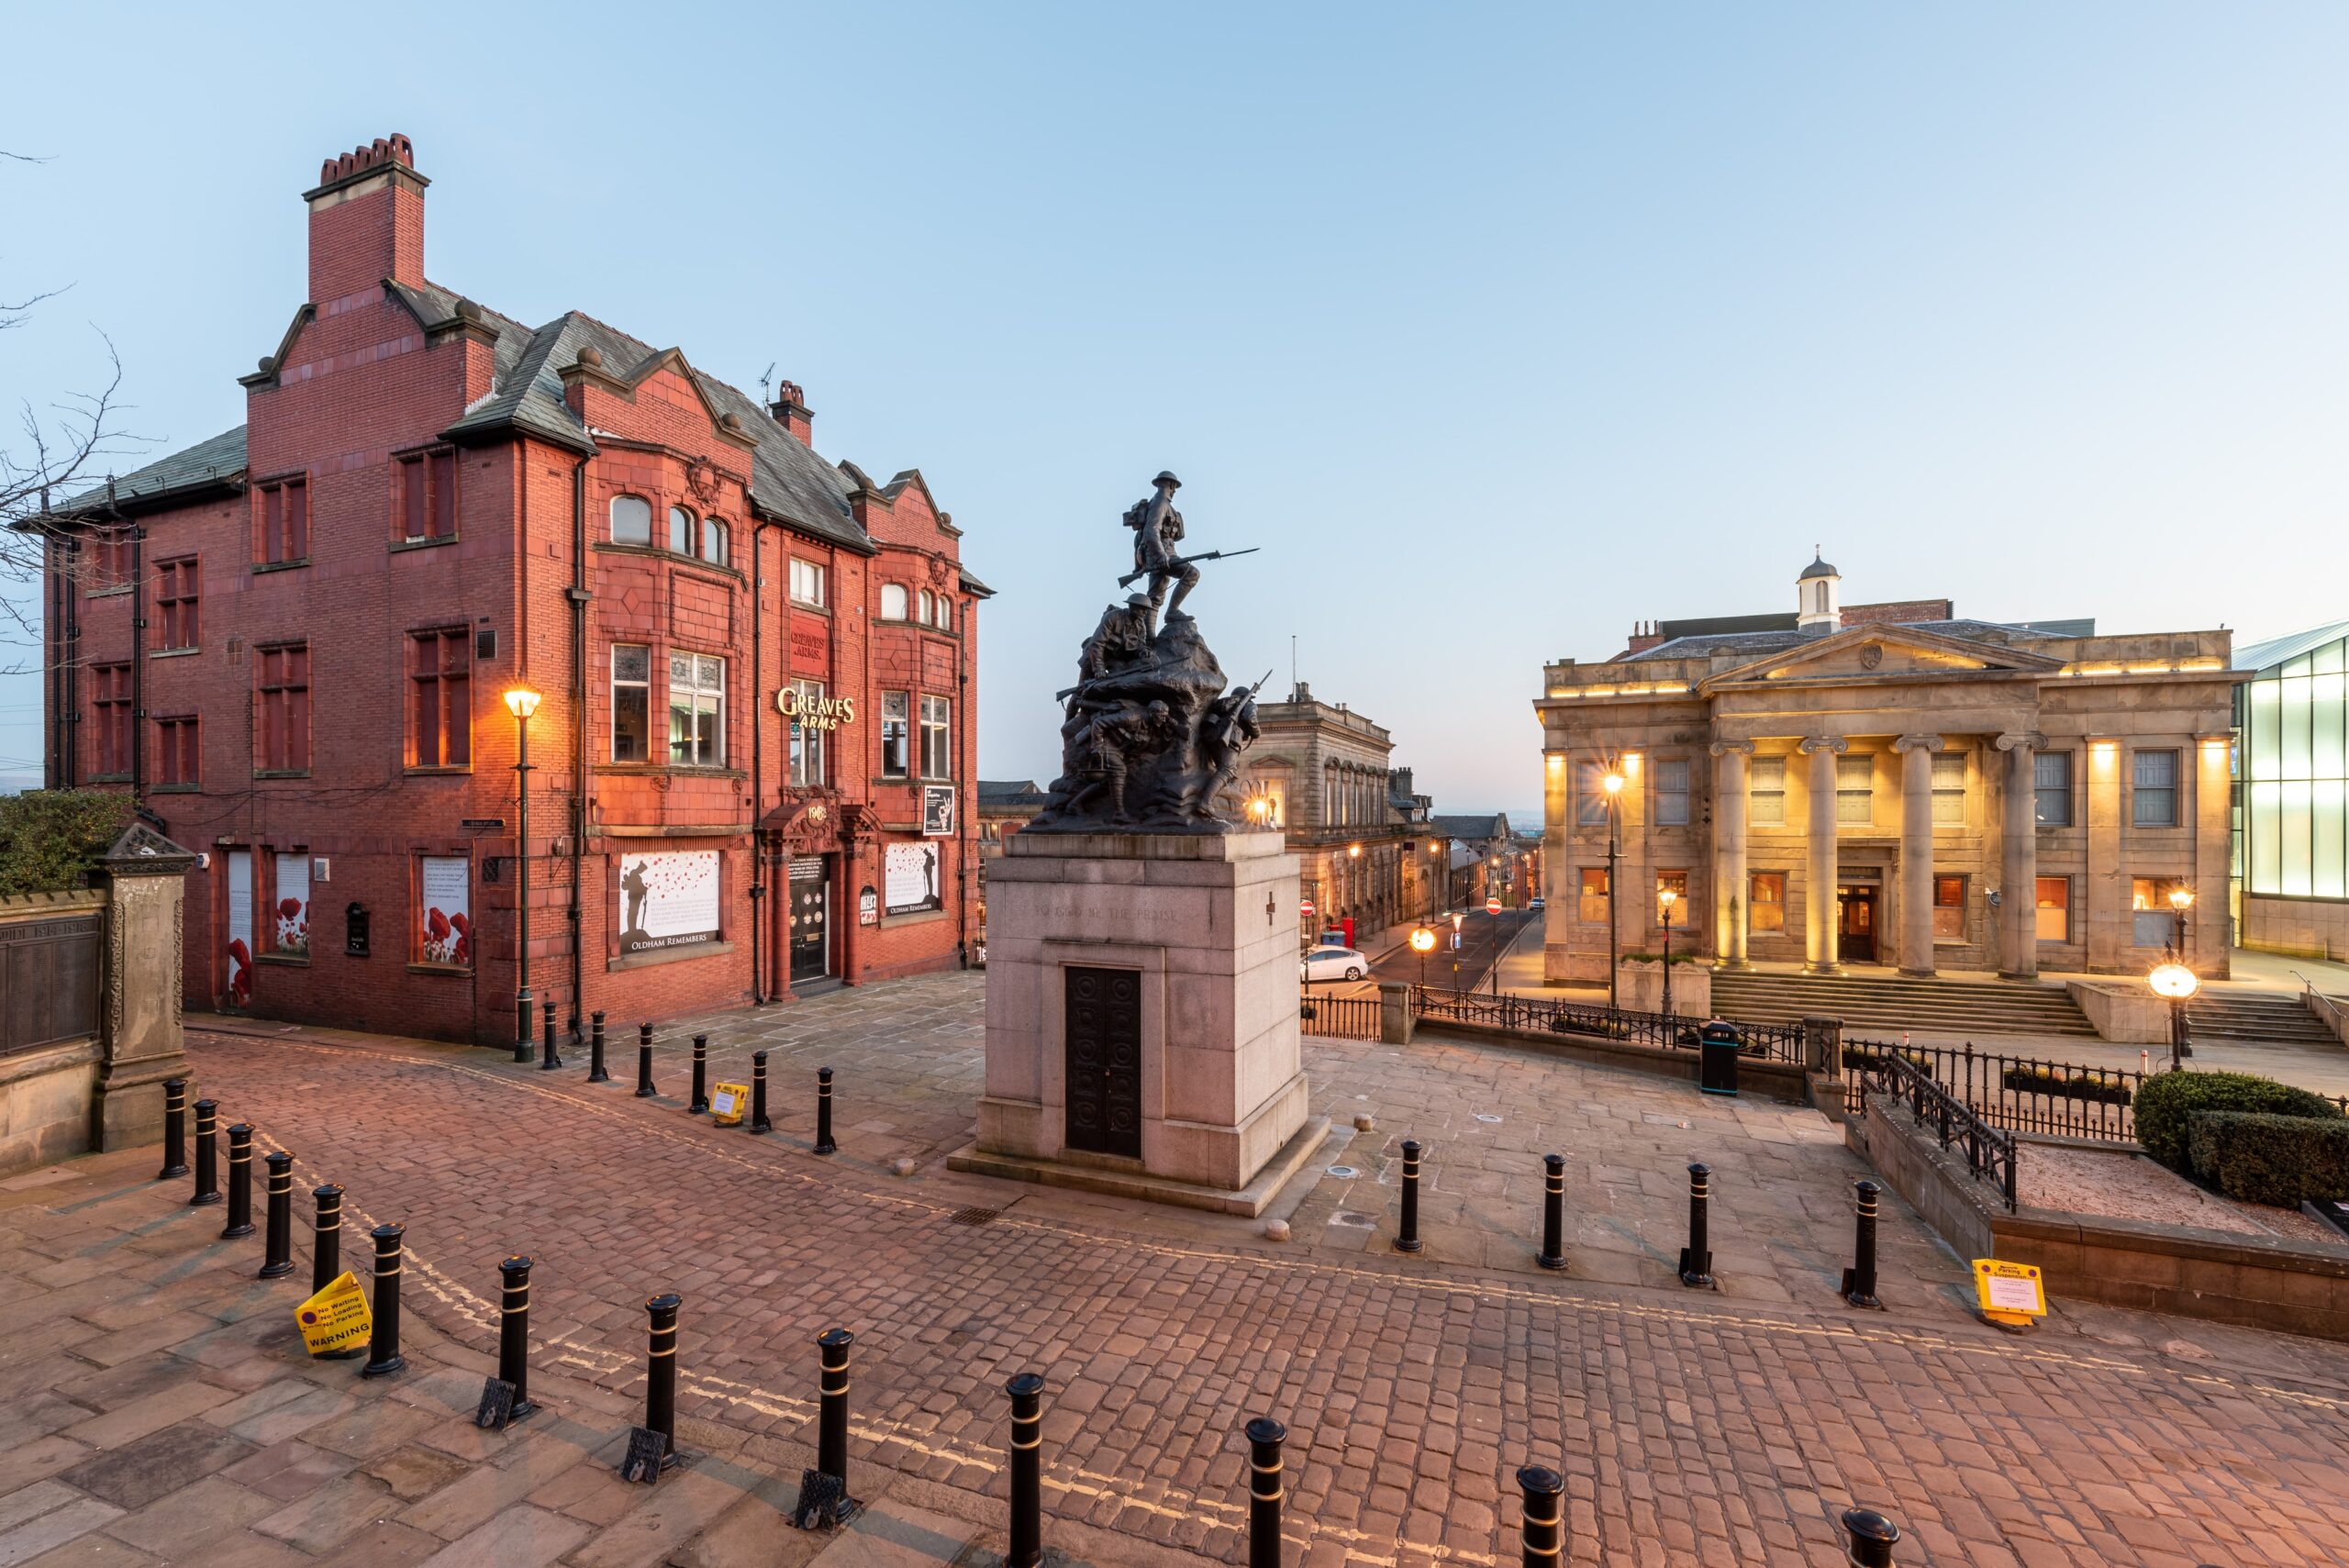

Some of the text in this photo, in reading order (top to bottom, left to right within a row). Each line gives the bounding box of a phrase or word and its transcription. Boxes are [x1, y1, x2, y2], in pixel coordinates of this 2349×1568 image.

[791, 633, 824, 650] GREAVES
[777, 687, 854, 723] GREAVES
[799, 715, 837, 730] ARMS
[631, 933, 707, 950] OLDHAM REMEMBERS
[330, 1296, 359, 1309] Waiting
[333, 1303, 362, 1316] Loading
[336, 1310, 363, 1323] Parking
[309, 1323, 370, 1347] WARNING
